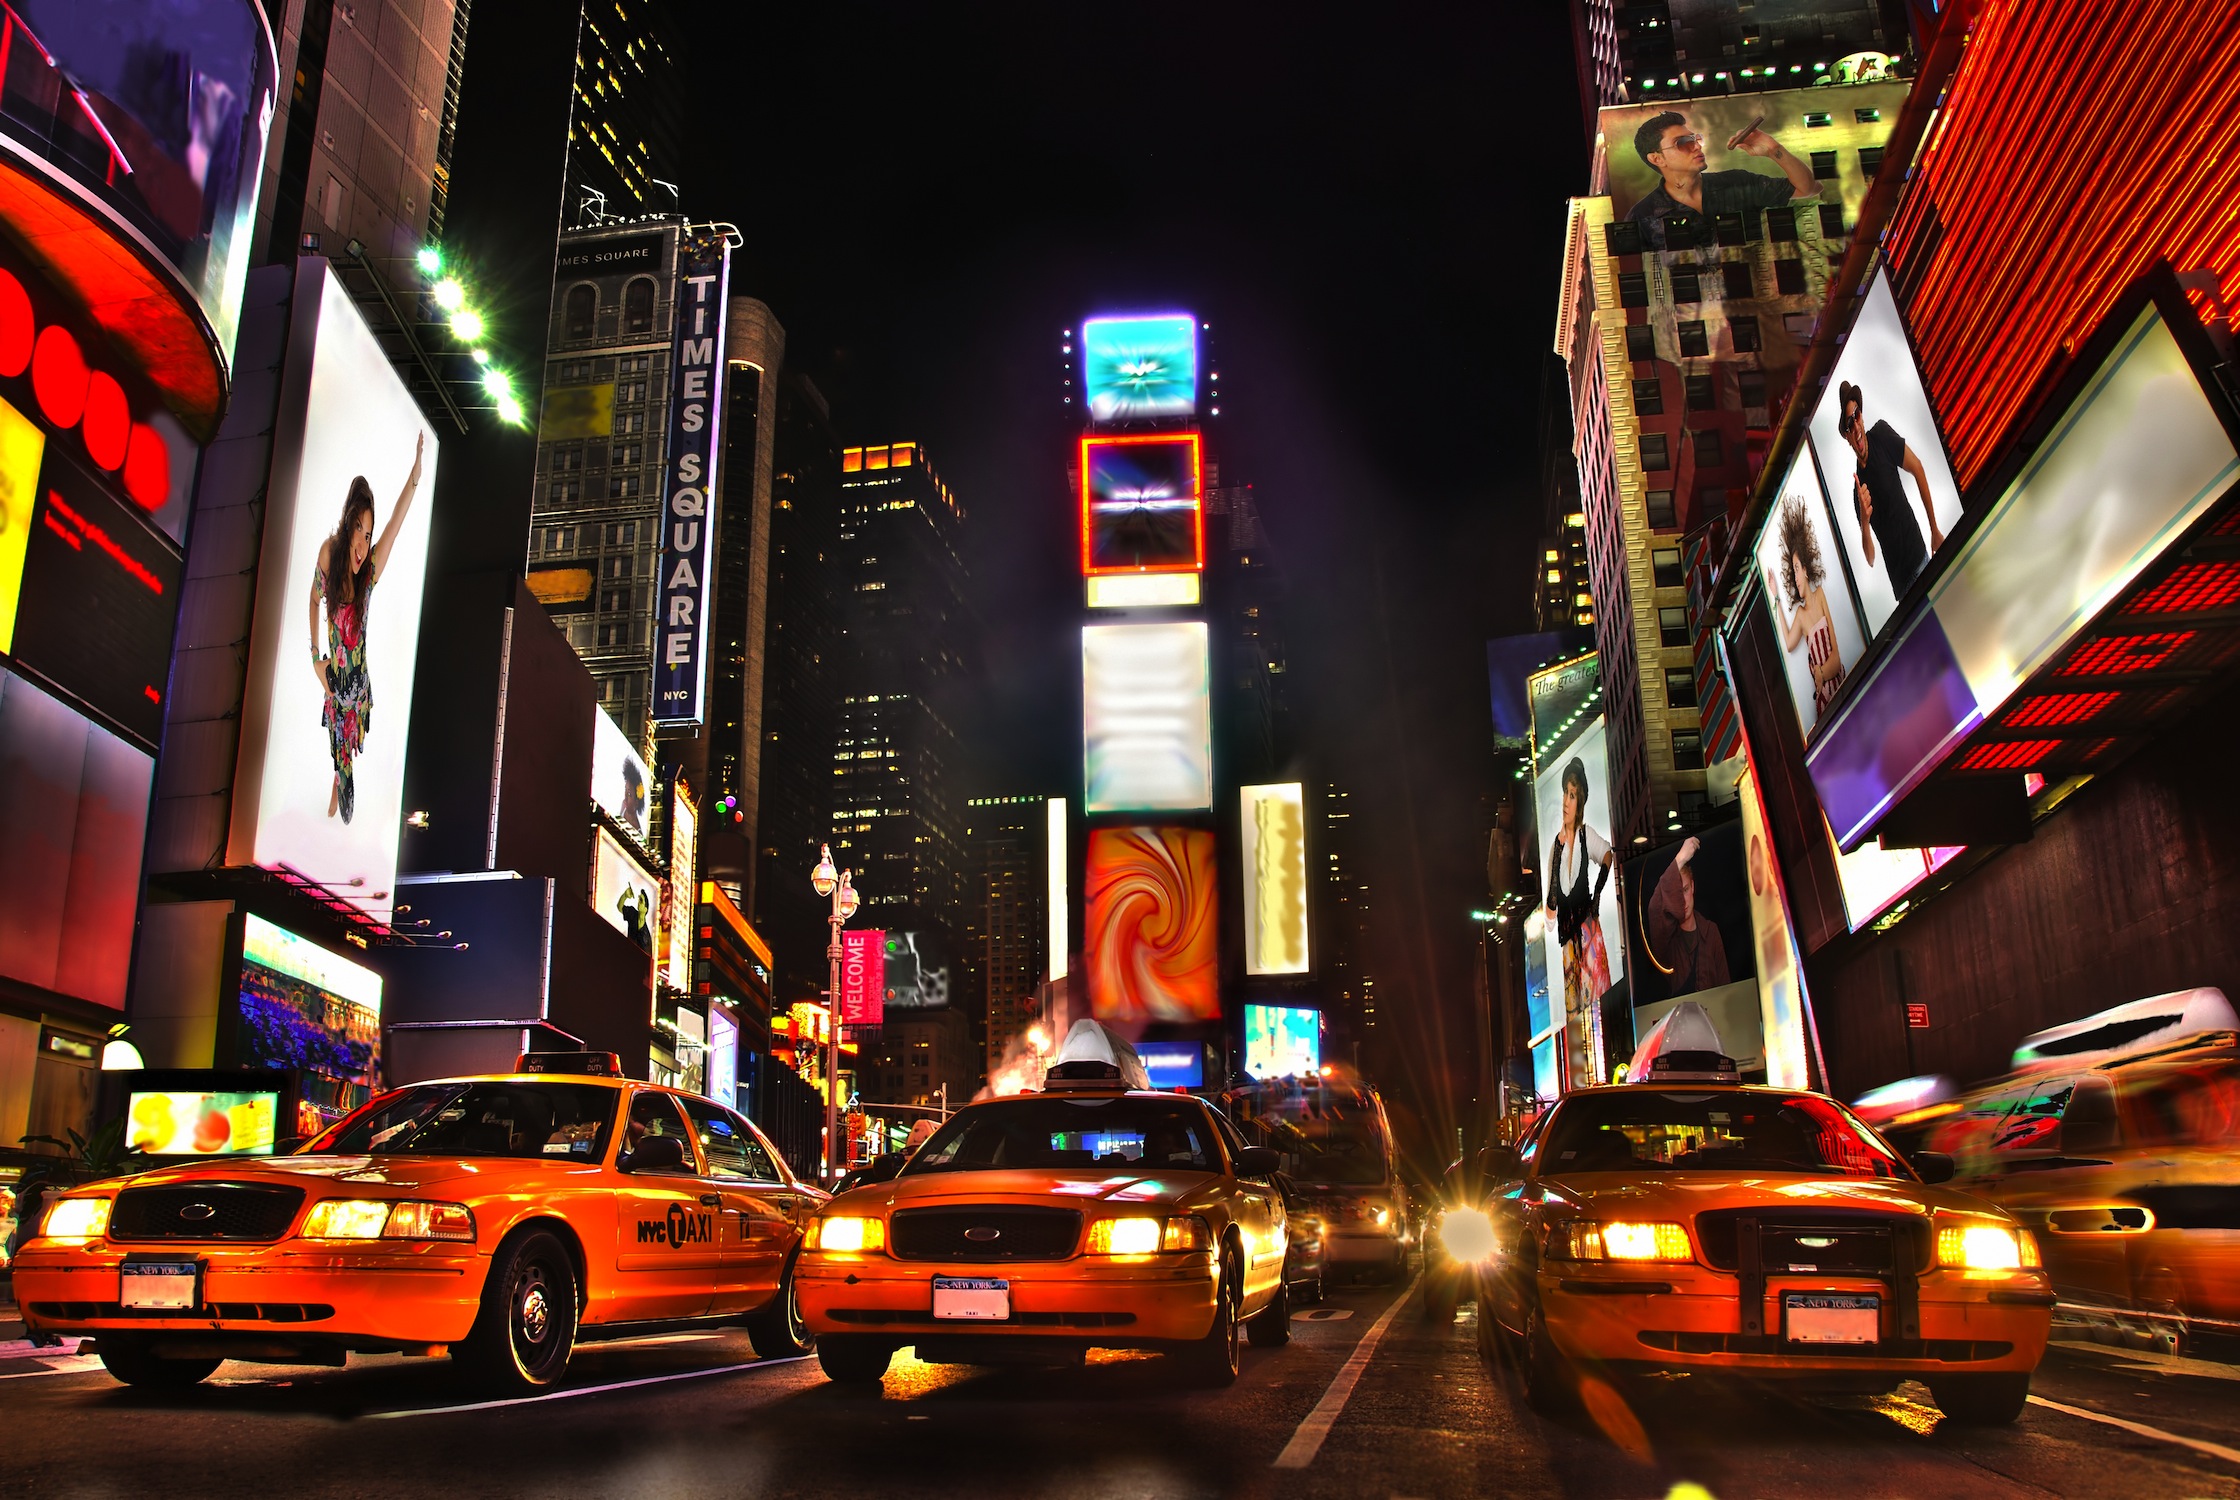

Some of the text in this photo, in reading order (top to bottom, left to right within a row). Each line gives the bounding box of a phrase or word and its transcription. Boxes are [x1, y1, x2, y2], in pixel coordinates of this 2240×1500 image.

[557, 248, 649, 266] IMES SQUARE
[665, 274, 717, 665] TIMES SQUARE
[663, 689, 688, 701] NYC
[1535, 677, 1555, 695] The
[846, 937, 865, 1021] WELCOME
[637, 1220, 667, 1243] NYC
[669, 1211, 713, 1243] TAXI
[140, 1266, 180, 1275] NEW YORK
[952, 1281, 992, 1289] NEW YORK
[1808, 1299, 1856, 1309] NEW YORK
